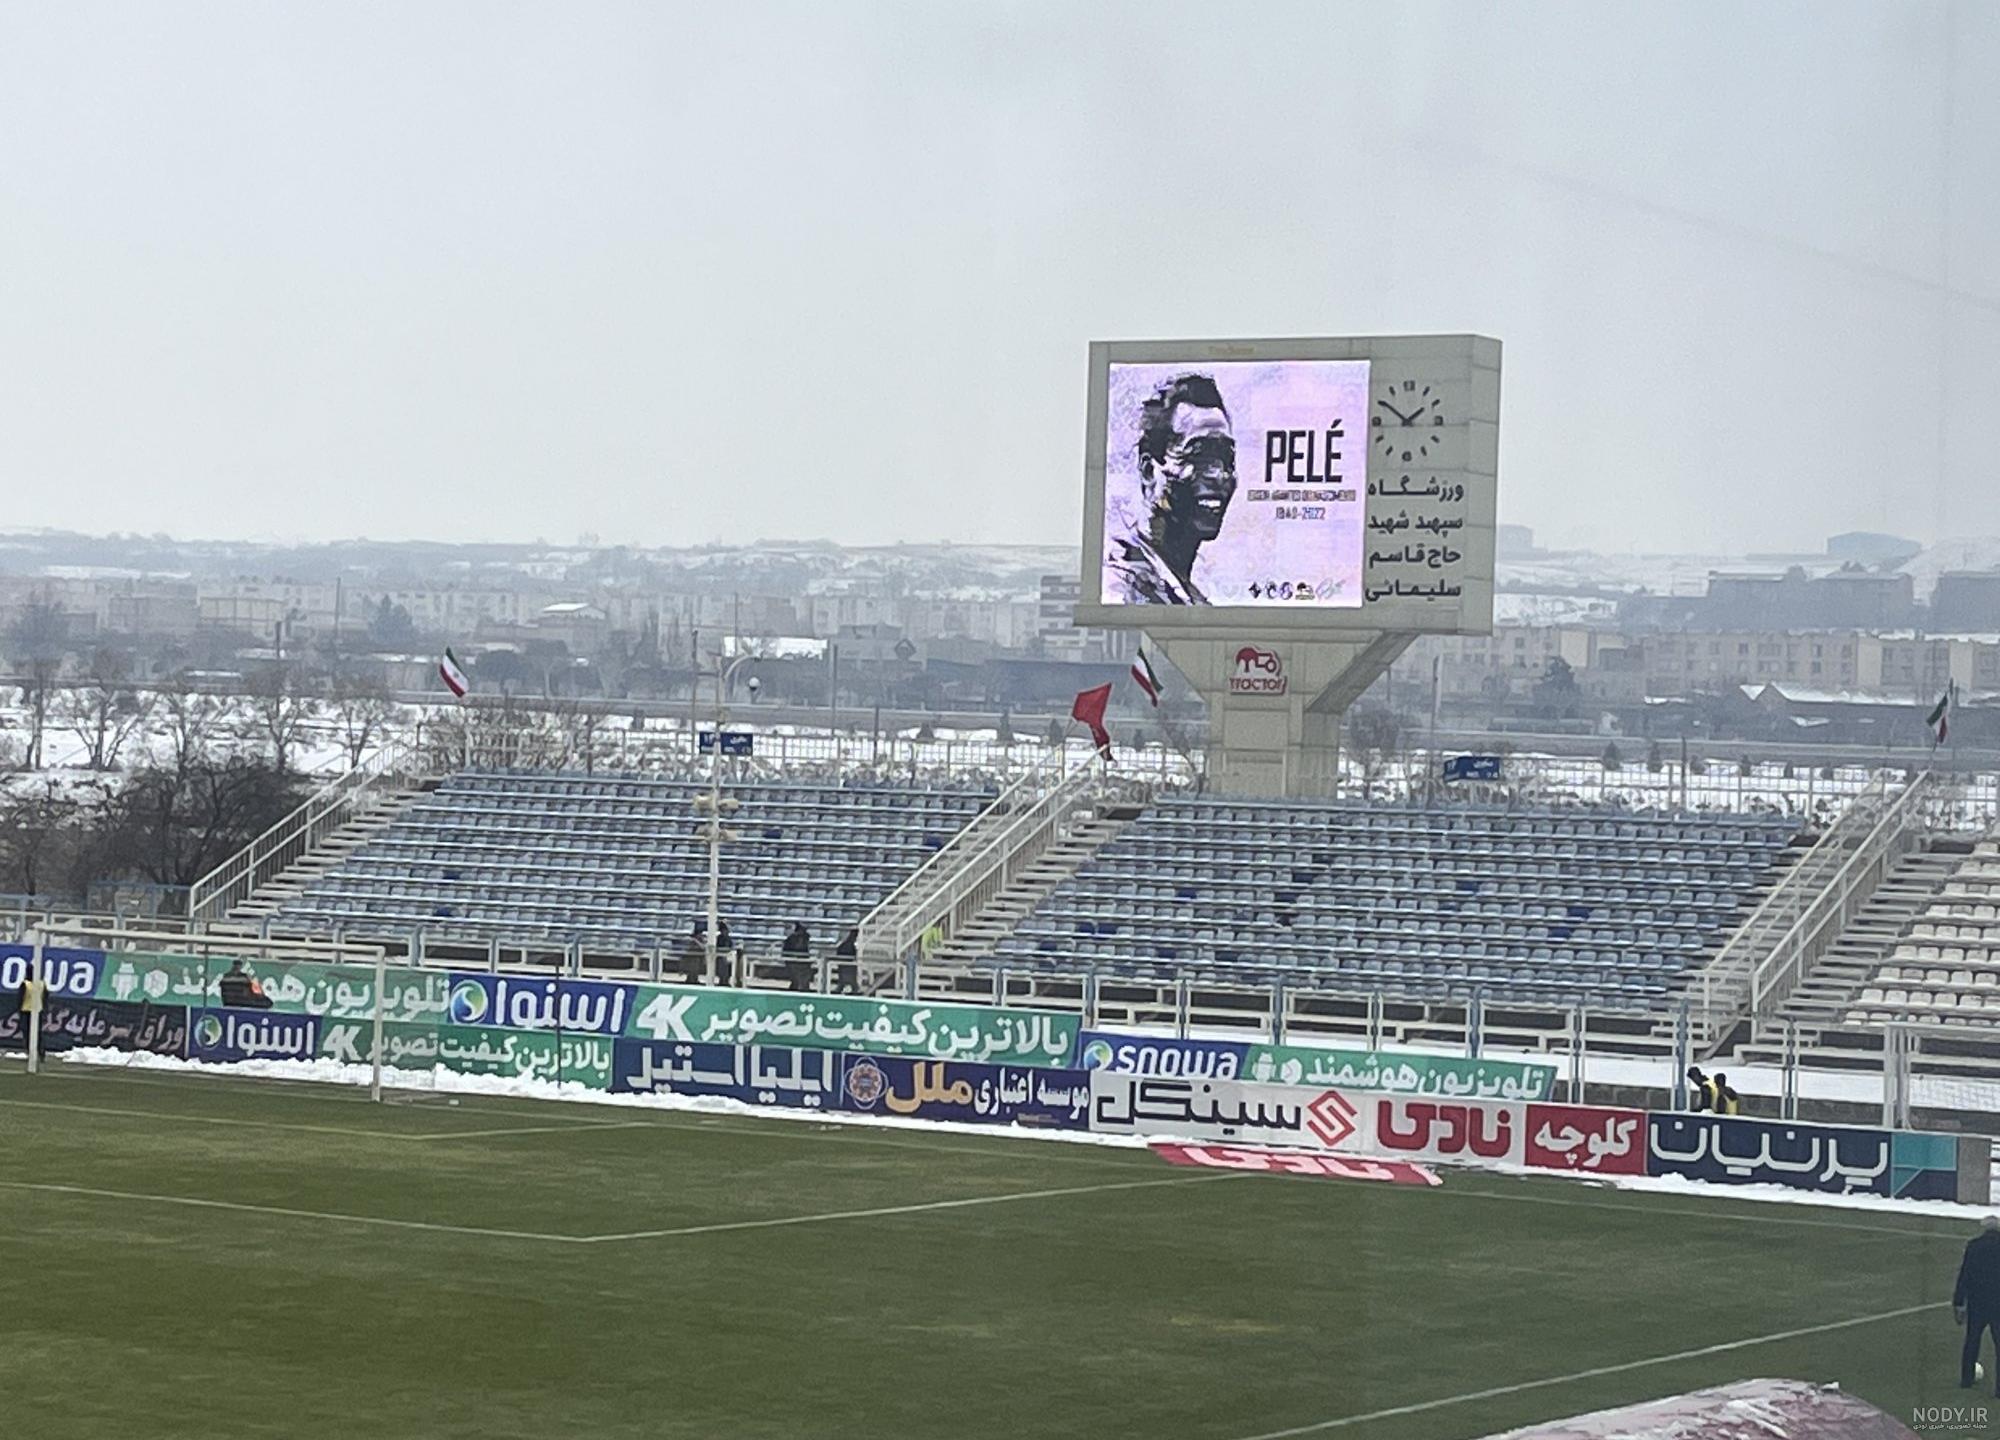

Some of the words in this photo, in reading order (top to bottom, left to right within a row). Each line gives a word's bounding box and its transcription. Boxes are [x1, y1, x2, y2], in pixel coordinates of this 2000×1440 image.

[1265, 418, 1344, 483] PELÉ
[1368, 475, 1464, 502] ورزشگاه
[1367, 509, 1410, 534] شهید
[1415, 515, 1463, 538] سپهبد
[1369, 542, 1425, 569] قاسم
[1428, 545, 1462, 568] حاج
[1365, 578, 1461, 602] سلیمانی
[495, 979, 626, 1033] اسنوا
[636, 993, 699, 1041] 4K
[700, 1003, 815, 1043] تصویر
[226, 1015, 314, 1056] اسنوا
[322, 1024, 363, 1061] 4K
[815, 1004, 932, 1053] کیفیت
[928, 1014, 1069, 1066] بالاترین
[439, 1032, 518, 1070] کیفیت
[515, 1040, 610, 1079] بالاترین
[626, 1044, 745, 1093] استیل
[1116, 1045, 1239, 1081] snowa
[750, 1045, 833, 1107] ایلیا
[885, 1061, 973, 1113] ملل
[1306, 1054, 1418, 1092] هوشمند
[1418, 1066, 1544, 1101] تلویزیون
[1534, 1116, 1638, 1167] کلوچه
[1650, 1121, 1888, 1194] پرنیان
